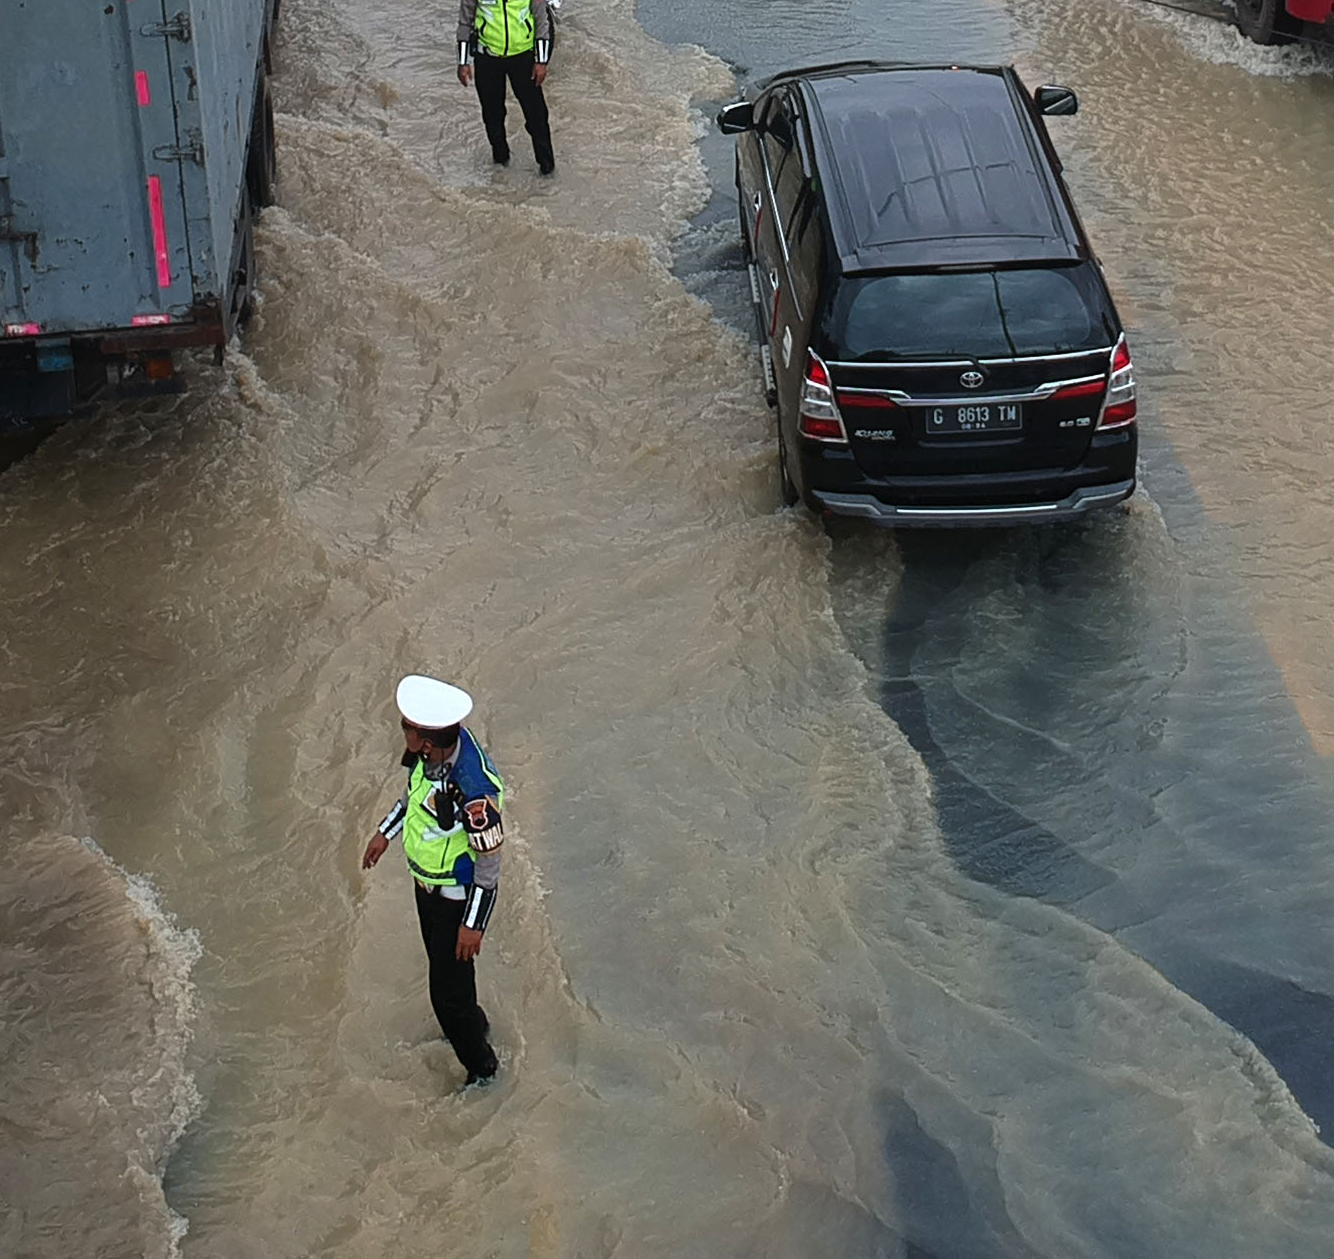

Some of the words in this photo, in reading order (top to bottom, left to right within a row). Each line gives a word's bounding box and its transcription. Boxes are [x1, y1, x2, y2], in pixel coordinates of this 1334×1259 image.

[933, 408, 943, 425] G
[957, 406, 989, 423] 8613
[469, 822, 504, 852] ATWAL
